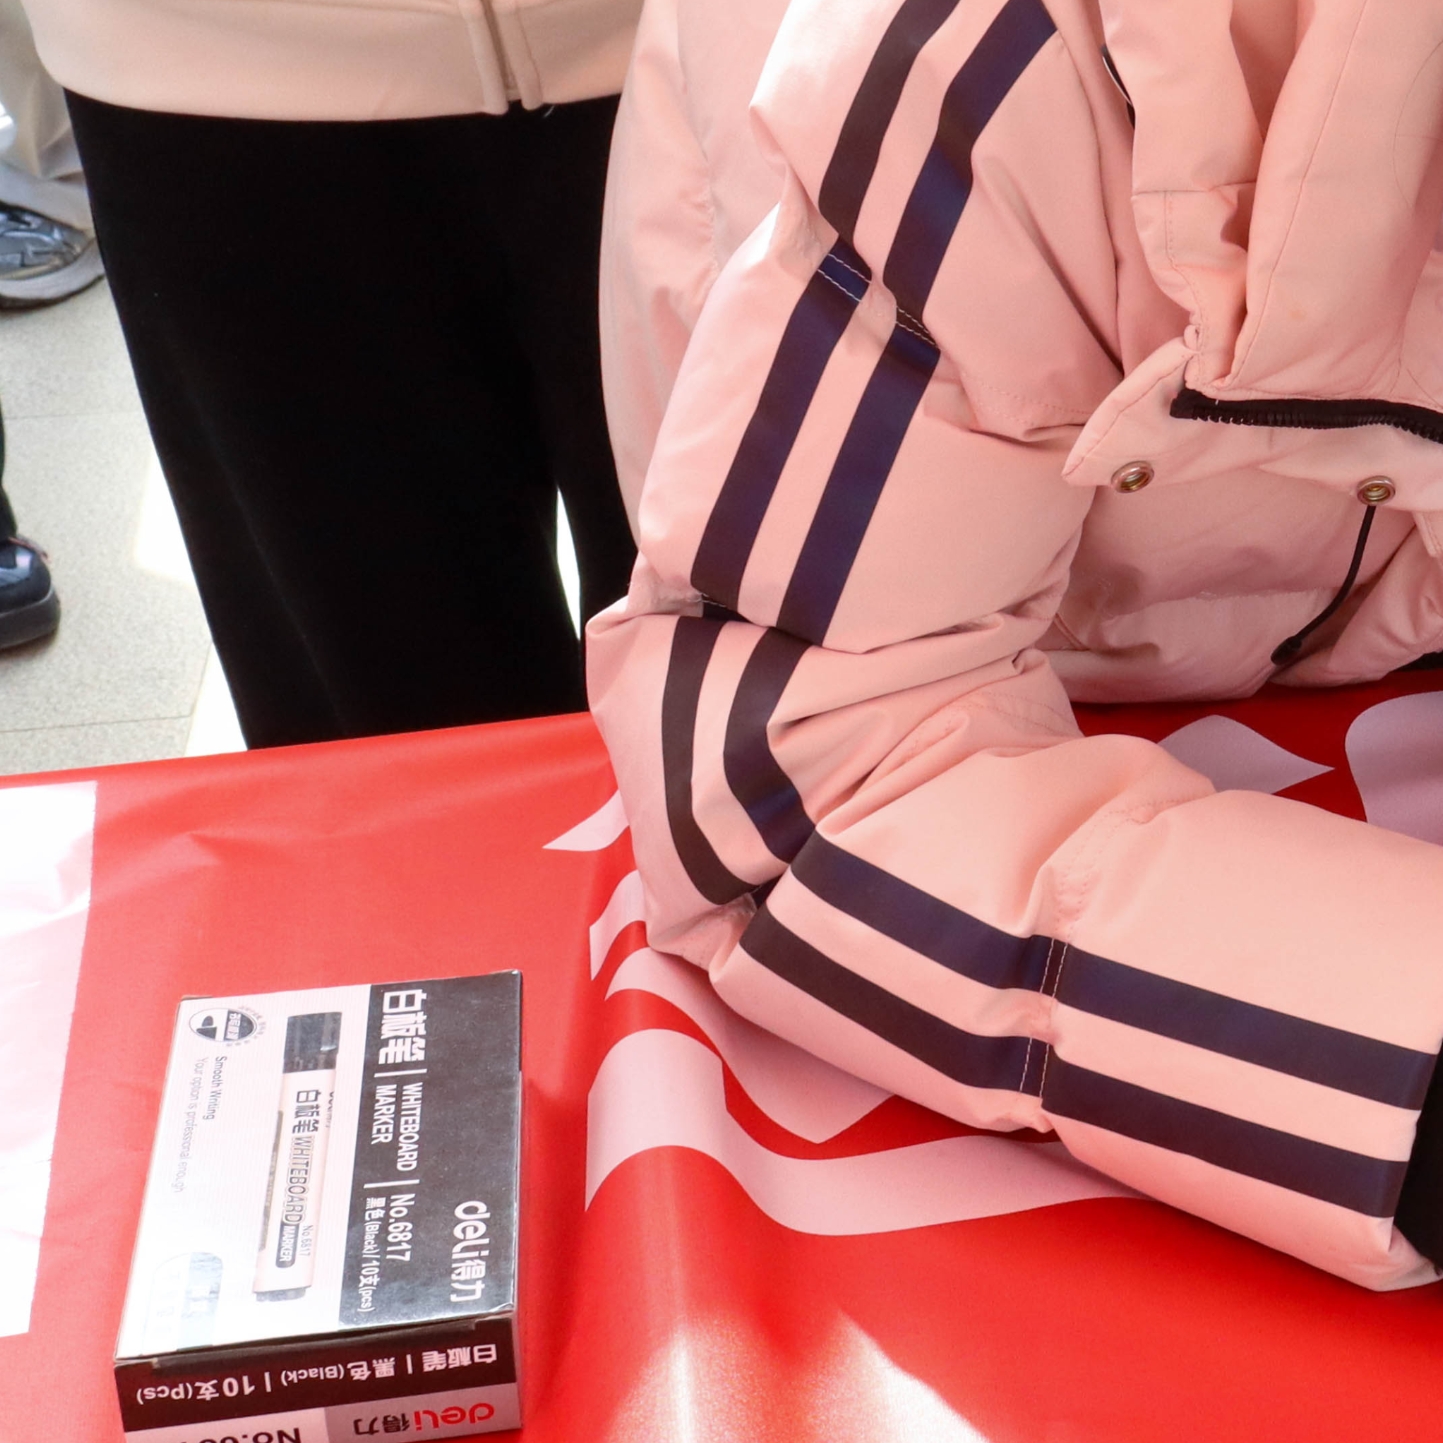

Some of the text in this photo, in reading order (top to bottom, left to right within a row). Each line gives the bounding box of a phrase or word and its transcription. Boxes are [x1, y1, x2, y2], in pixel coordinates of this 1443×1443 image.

[379, 989, 427, 1067] 白板笔
[371, 1083, 396, 1146] MARKER
[397, 1081, 423, 1172] WHITEBOARD
[385, 1194, 415, 1263] No.6817
